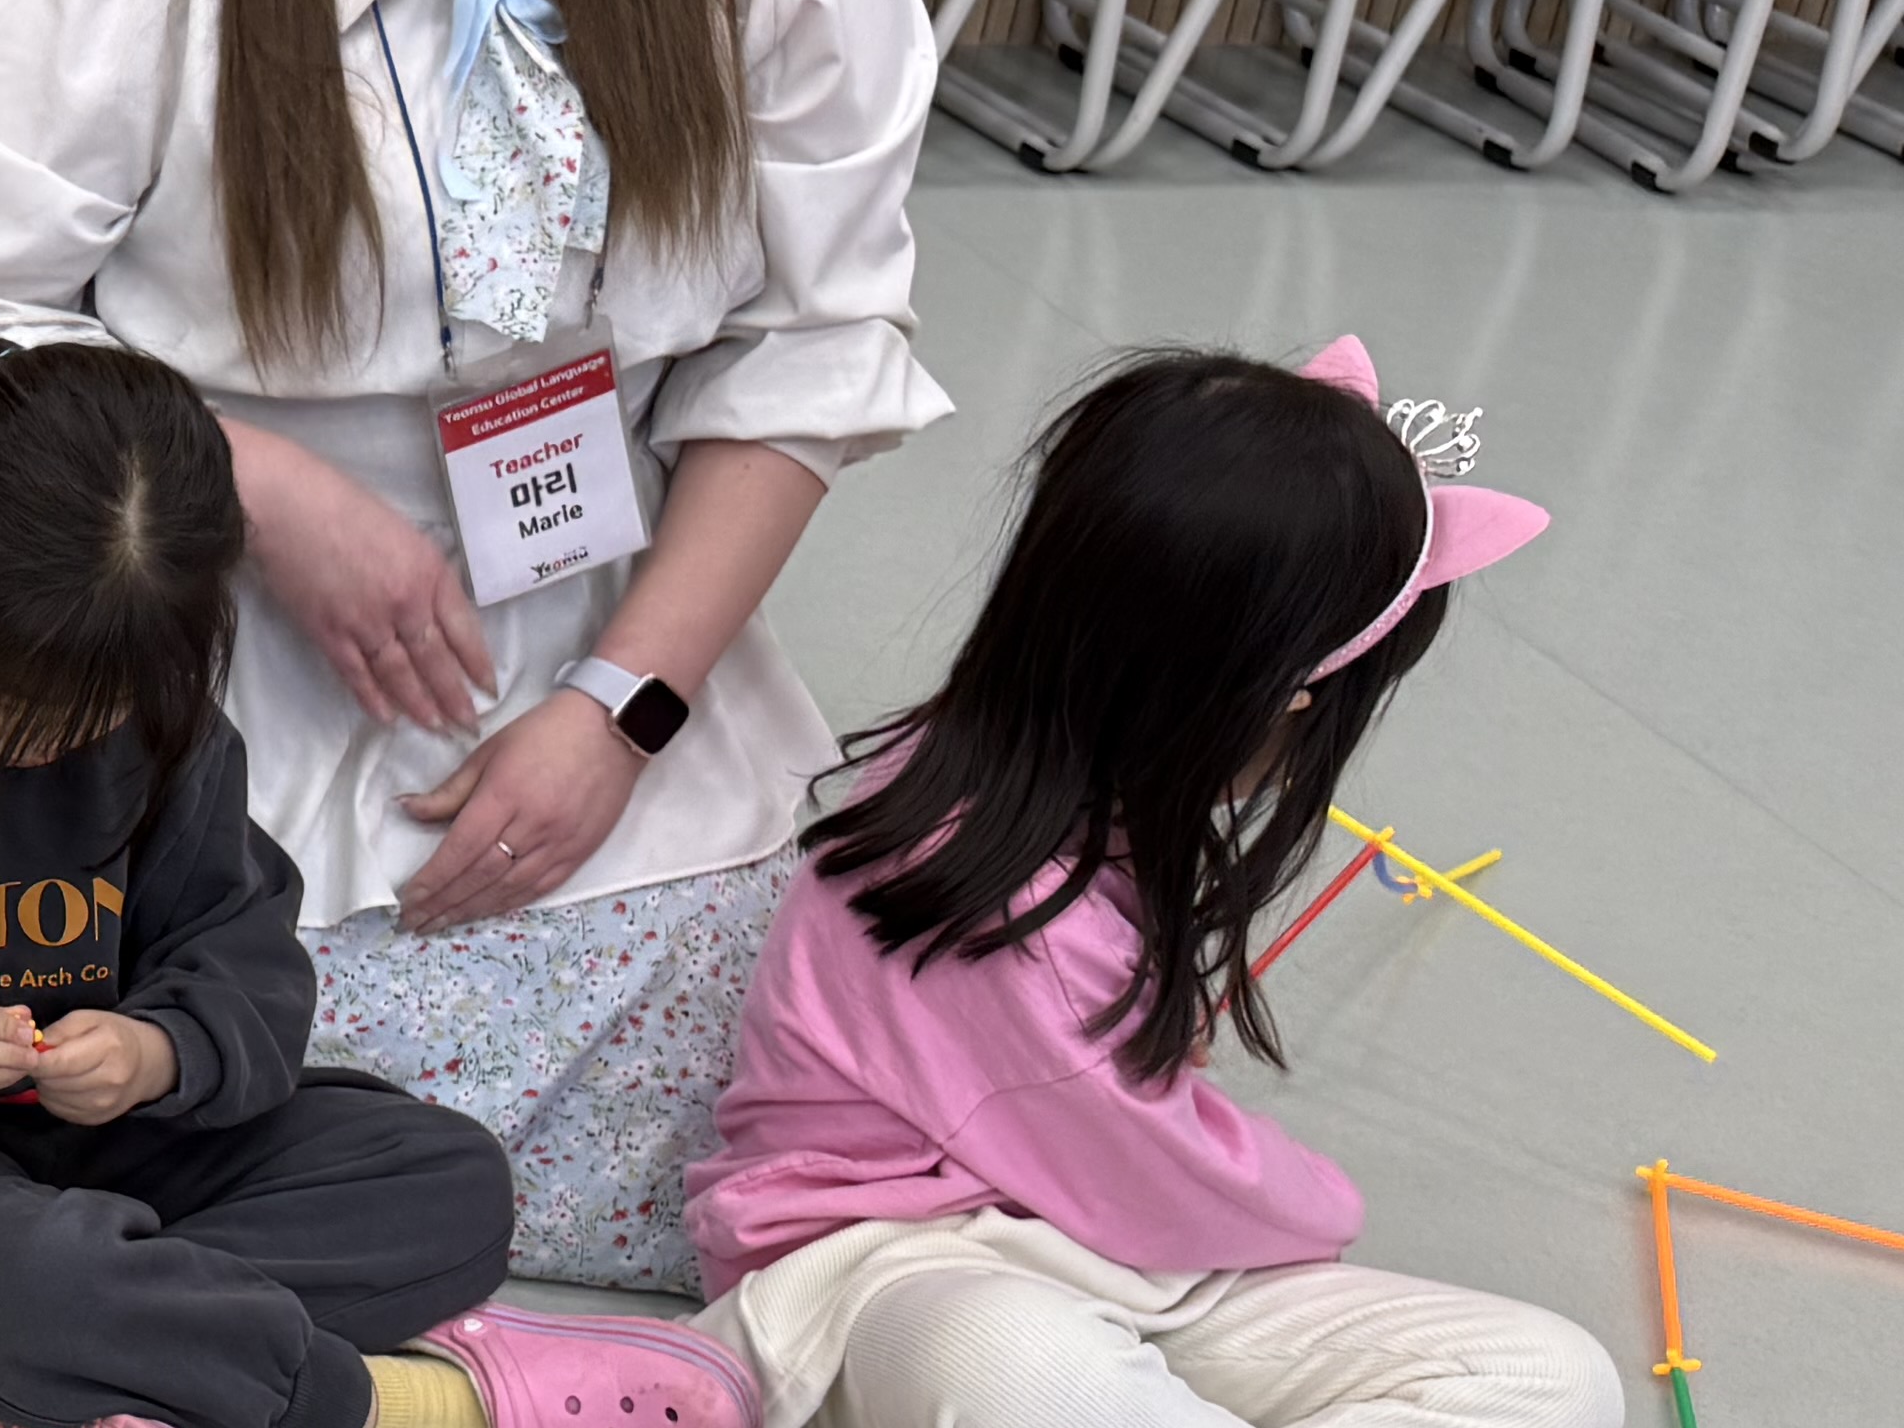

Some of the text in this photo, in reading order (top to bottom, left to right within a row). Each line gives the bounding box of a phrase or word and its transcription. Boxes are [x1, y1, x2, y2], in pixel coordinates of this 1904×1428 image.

[495, 380, 538, 405] Global
[542, 356, 605, 387] Language
[471, 386, 584, 435] Education Center
[490, 433, 583, 479] Teacher
[510, 462, 577, 508] 마리
[519, 504, 583, 540] Marie
[19, 966, 72, 988] Arch
